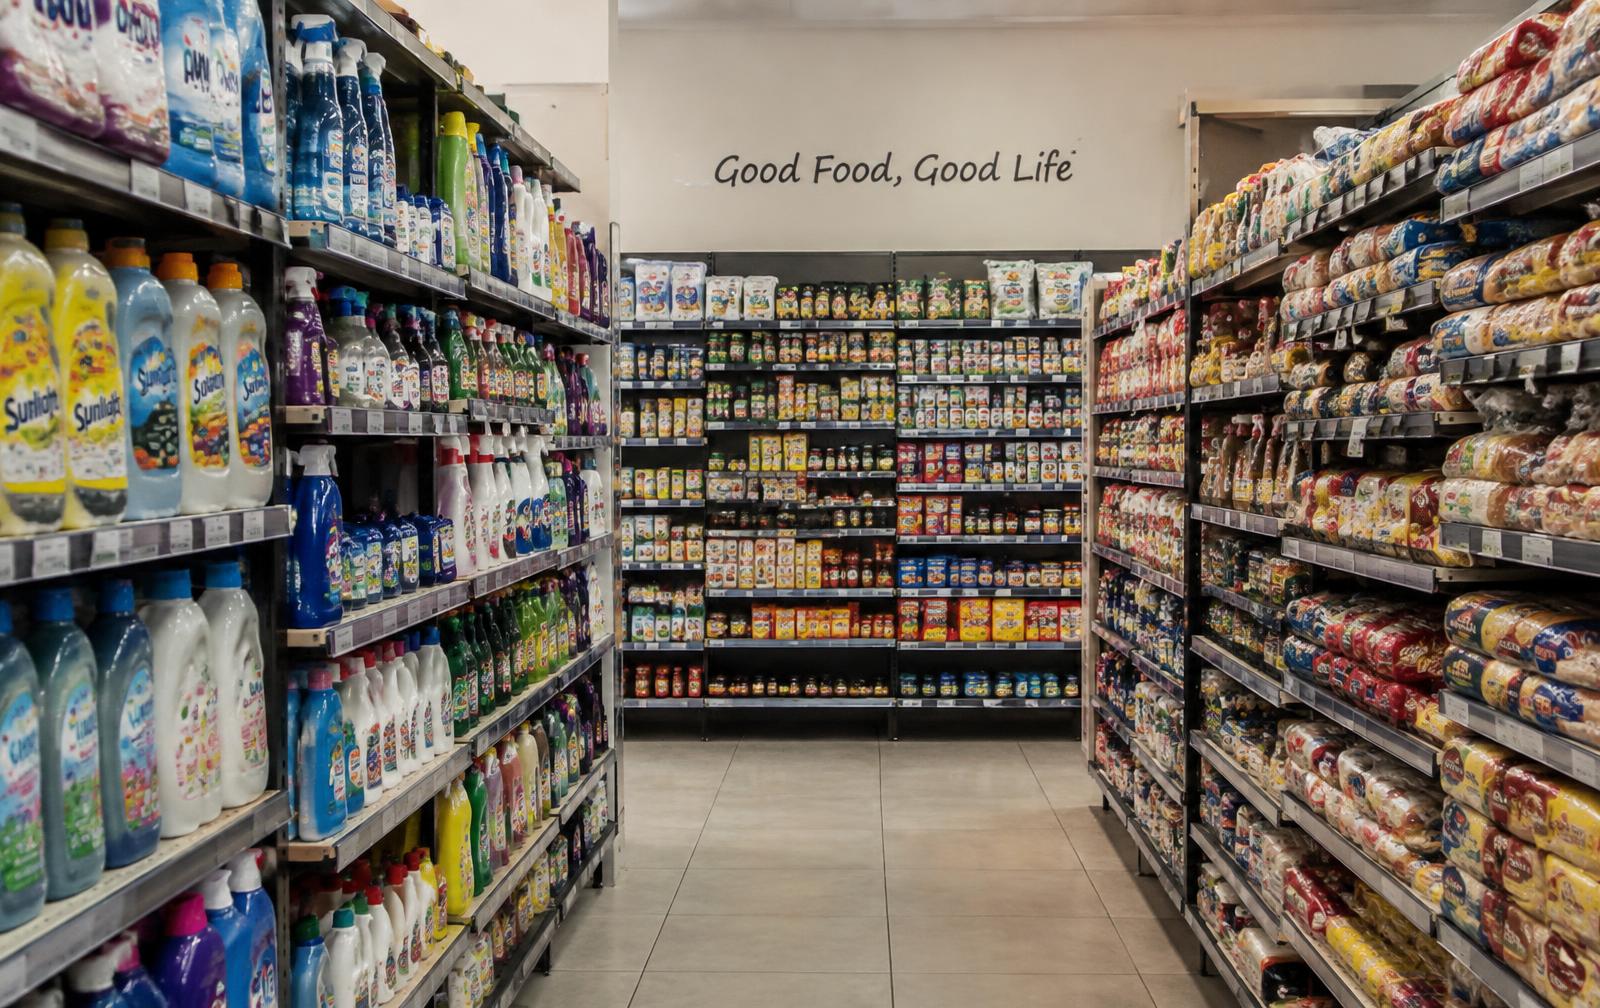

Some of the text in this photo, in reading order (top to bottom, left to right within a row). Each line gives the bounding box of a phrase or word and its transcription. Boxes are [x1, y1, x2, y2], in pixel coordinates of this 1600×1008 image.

[714, 149, 1073, 187] Good Food, Good Life
